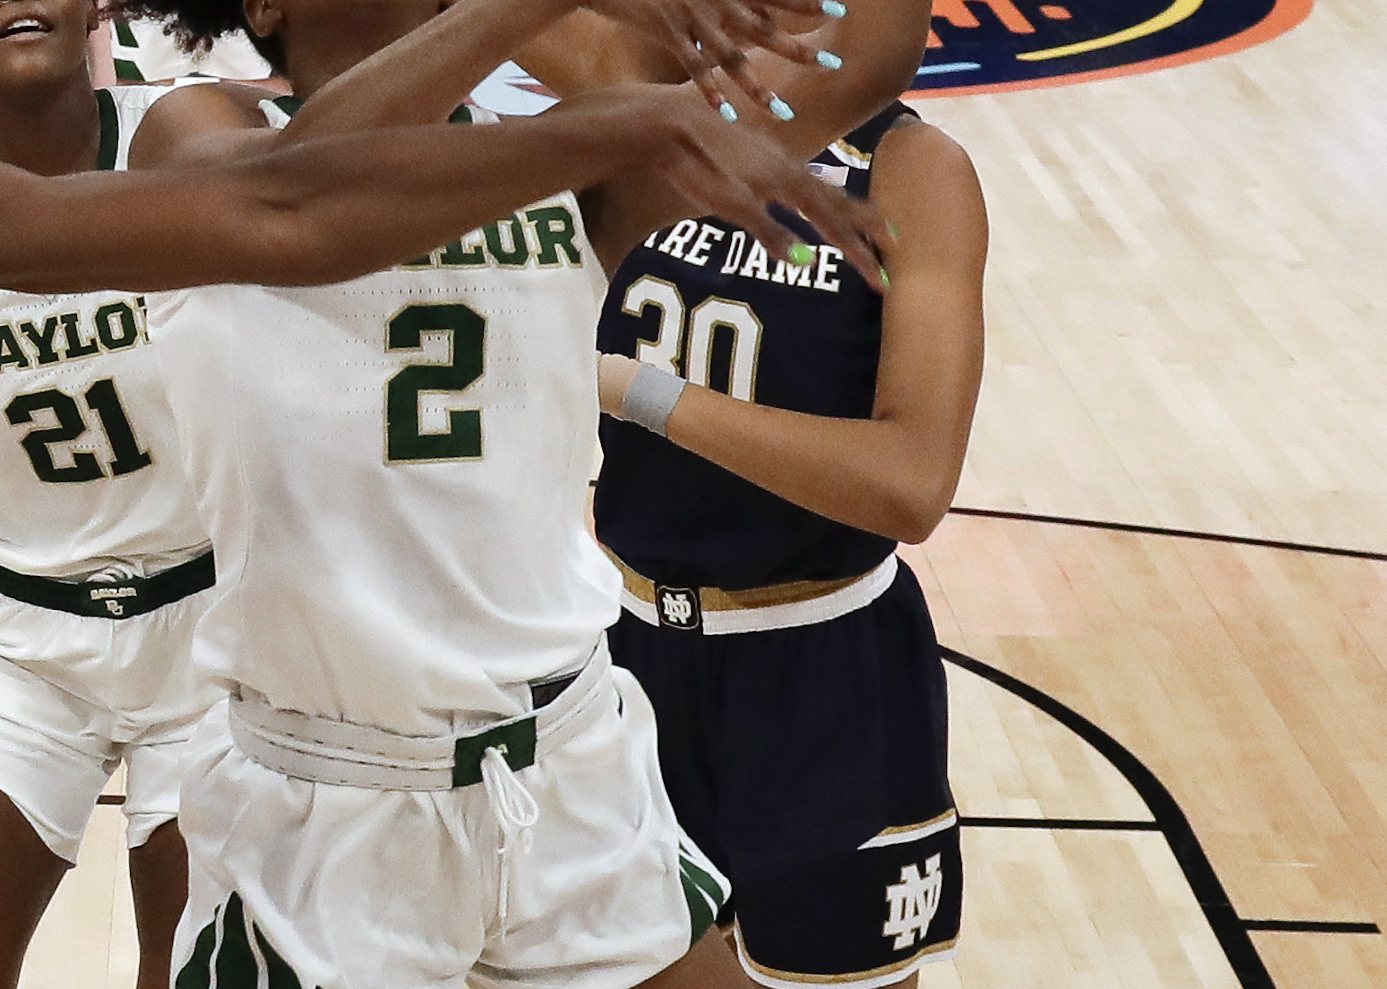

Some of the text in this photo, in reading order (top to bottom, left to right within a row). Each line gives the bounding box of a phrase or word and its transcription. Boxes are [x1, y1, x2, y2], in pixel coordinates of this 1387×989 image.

[384, 301, 489, 465] 2
[621, 274, 764, 404] 30
[4, 376, 154, 484] 21
